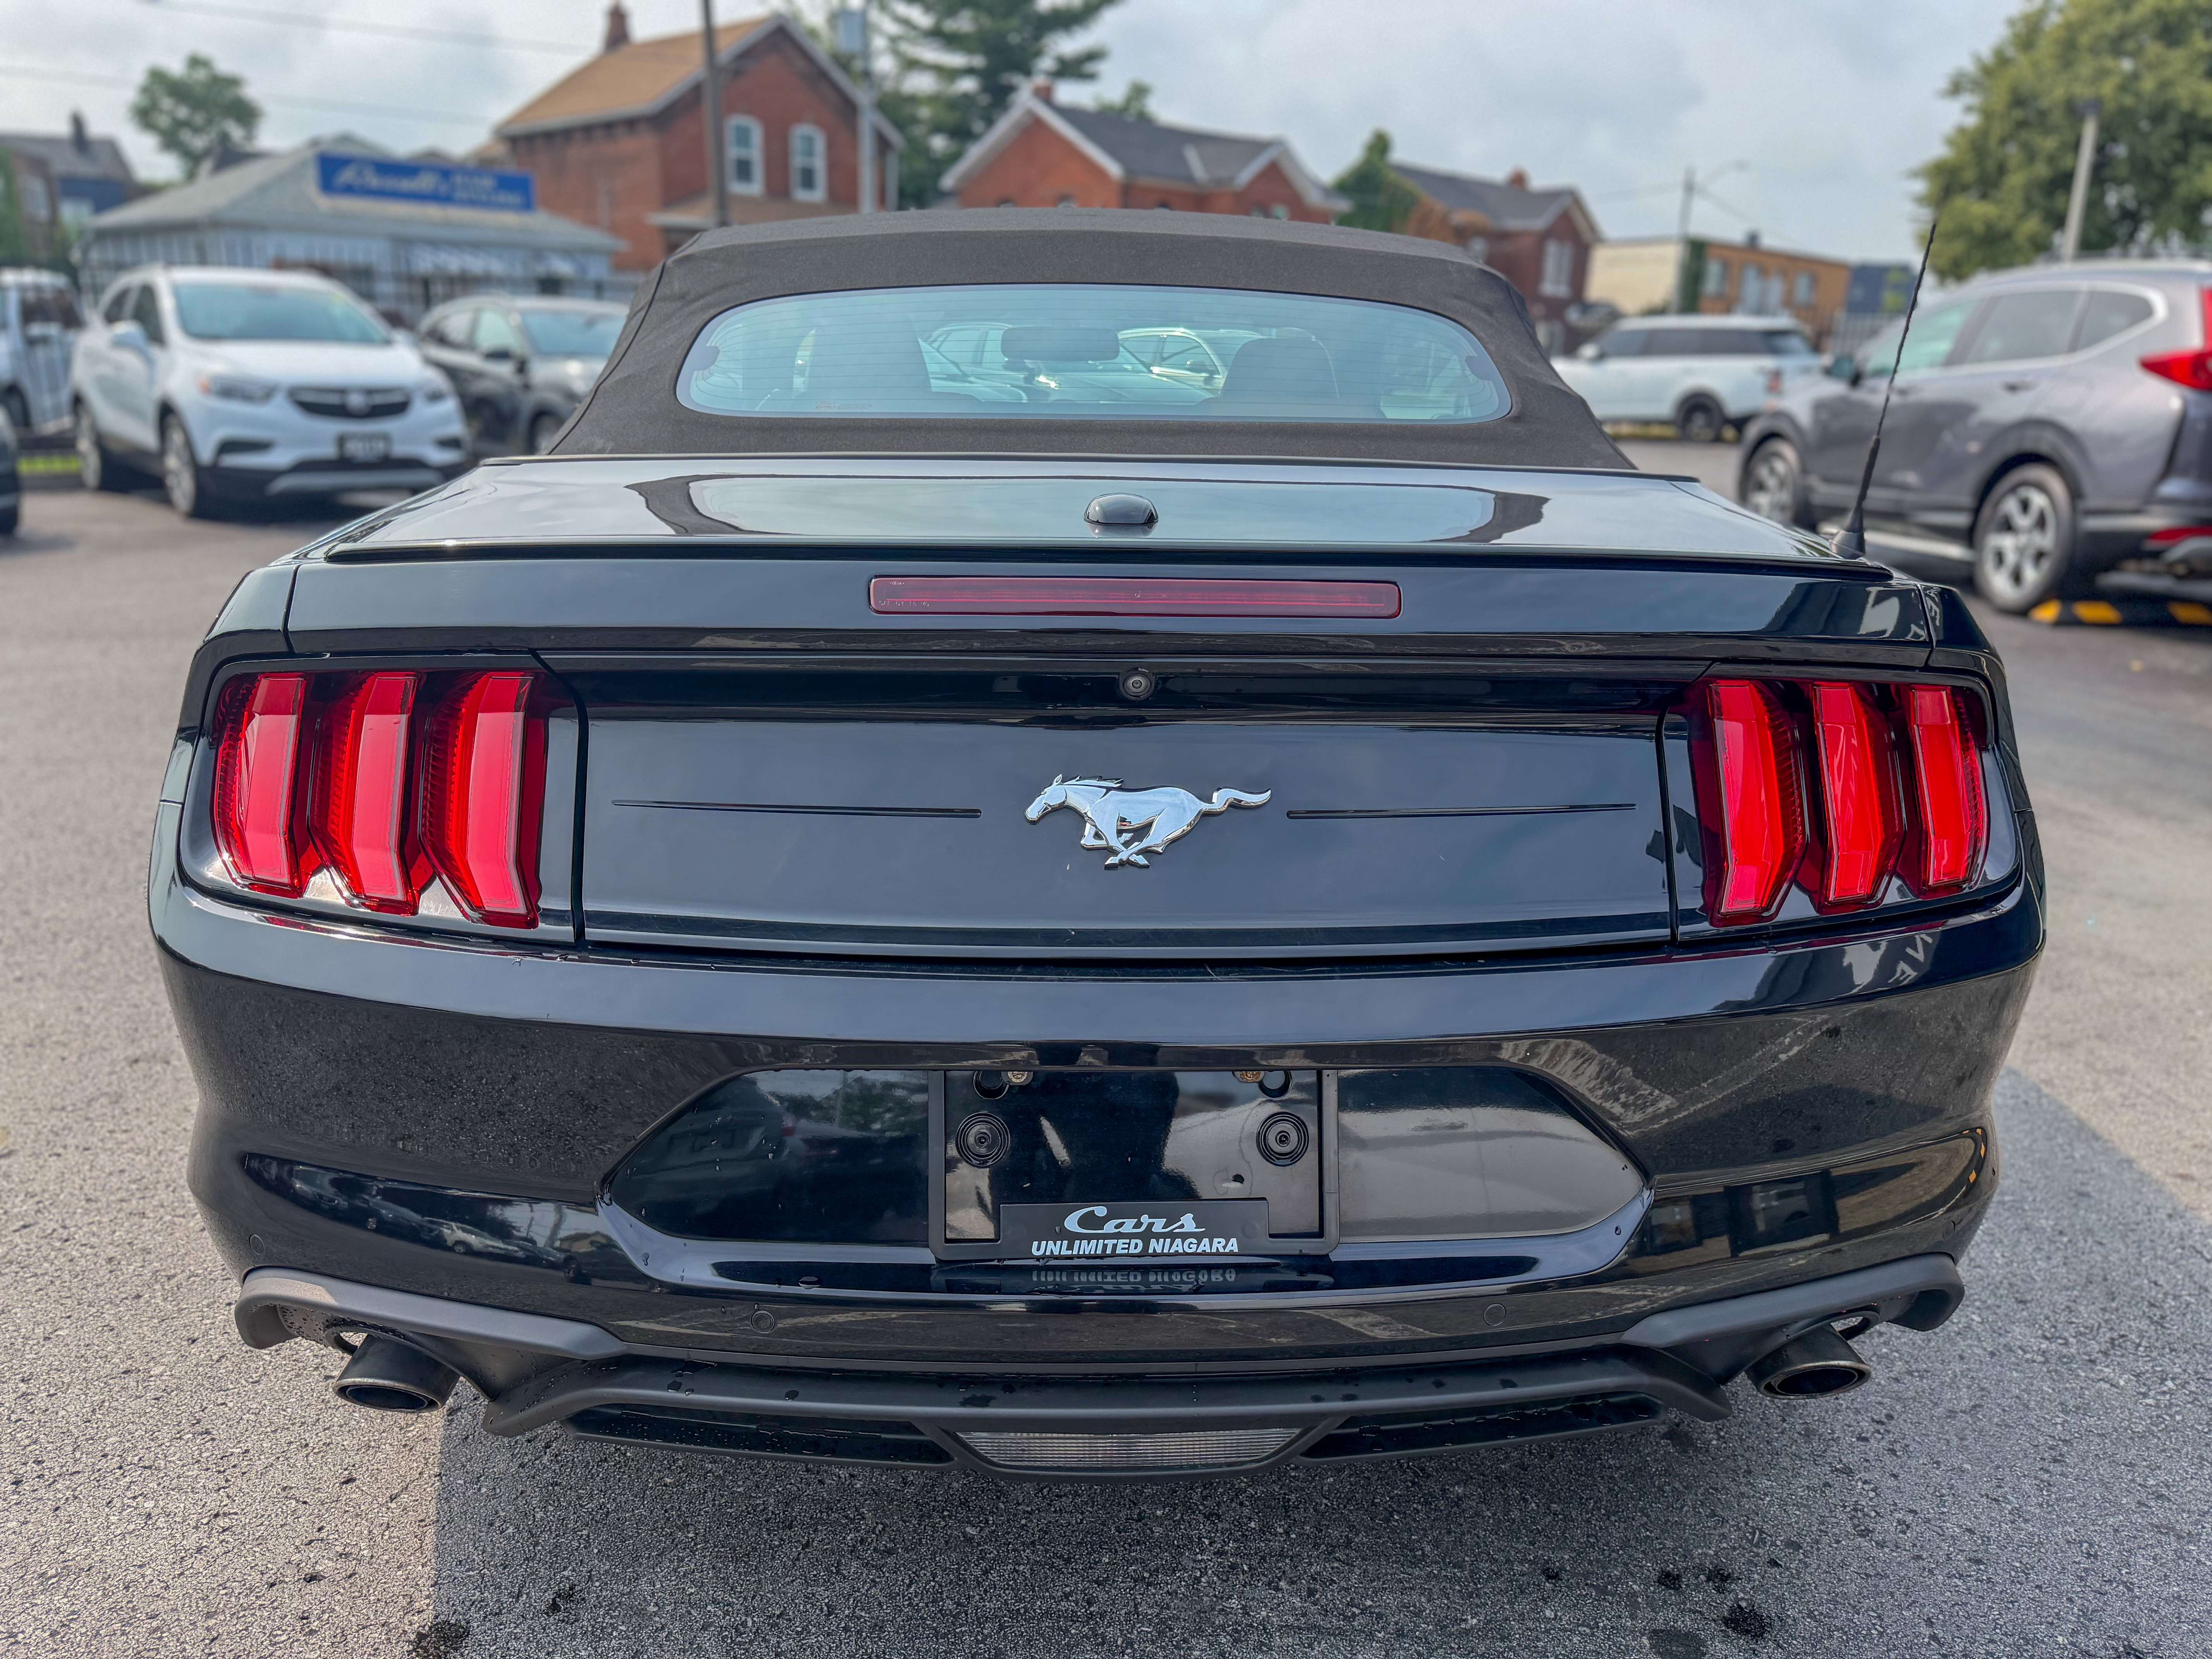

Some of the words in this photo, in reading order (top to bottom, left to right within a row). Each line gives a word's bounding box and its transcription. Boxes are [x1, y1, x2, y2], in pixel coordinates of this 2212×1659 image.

[1064, 1206, 1206, 1233] Cars
[1032, 1239, 1143, 1255] UNLIMITED
[1148, 1238, 1238, 1253] NIAGARA
